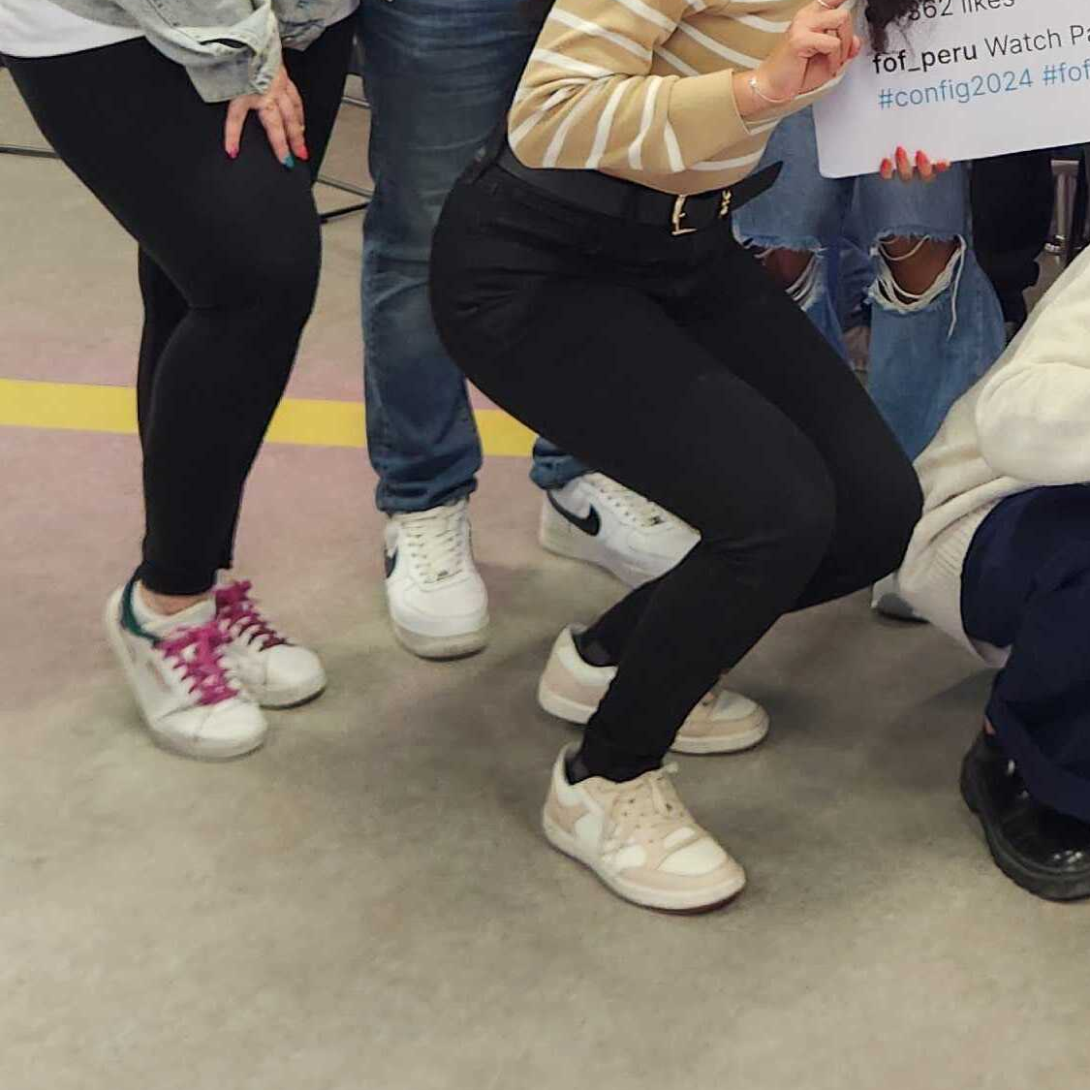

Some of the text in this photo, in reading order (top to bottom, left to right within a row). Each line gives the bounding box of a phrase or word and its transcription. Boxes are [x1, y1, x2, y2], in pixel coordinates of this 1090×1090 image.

[872, 43, 979, 75] fof_peru
[984, 27, 1063, 59] Watch
[877, 67, 1035, 110] #config2024
